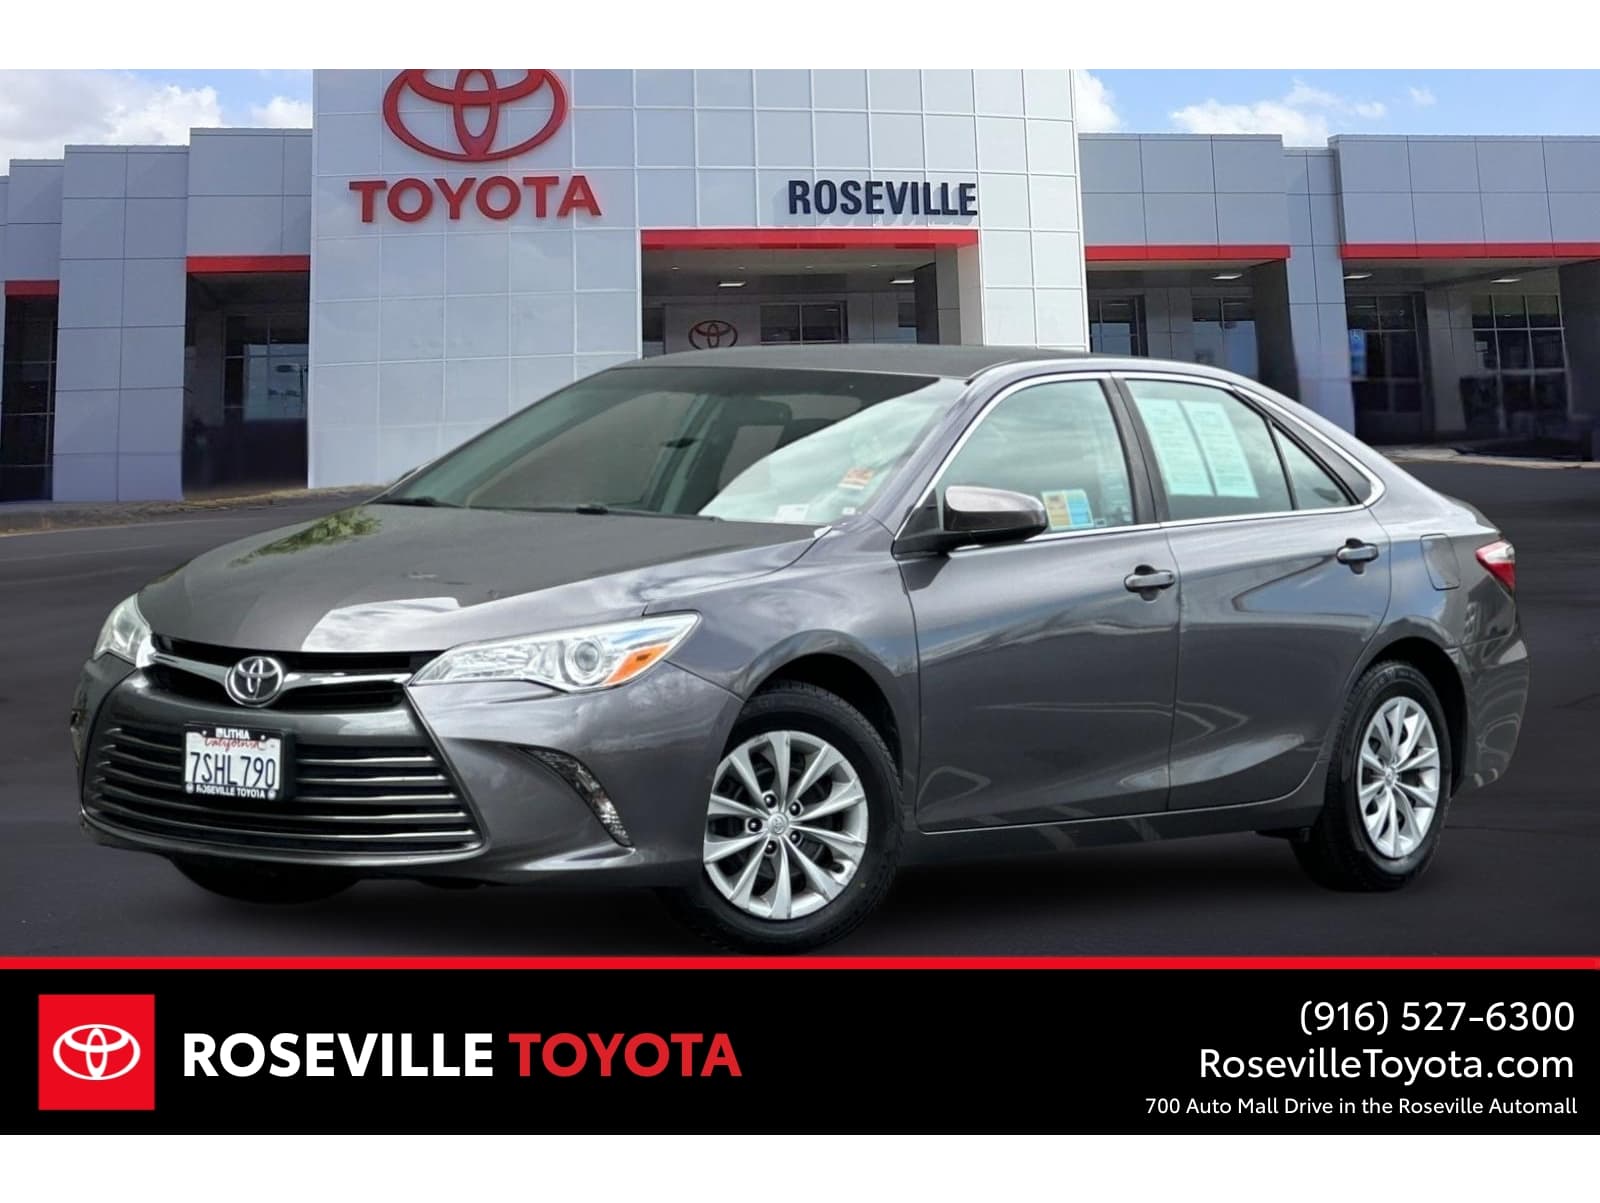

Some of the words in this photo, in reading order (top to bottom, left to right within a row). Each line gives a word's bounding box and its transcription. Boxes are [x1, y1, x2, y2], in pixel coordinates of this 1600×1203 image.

[348, 175, 602, 223] TOYOTA
[788, 179, 978, 216] ROSEVILLE
[223, 728, 250, 740] LITHIA
[190, 752, 276, 788] 7SHL790
